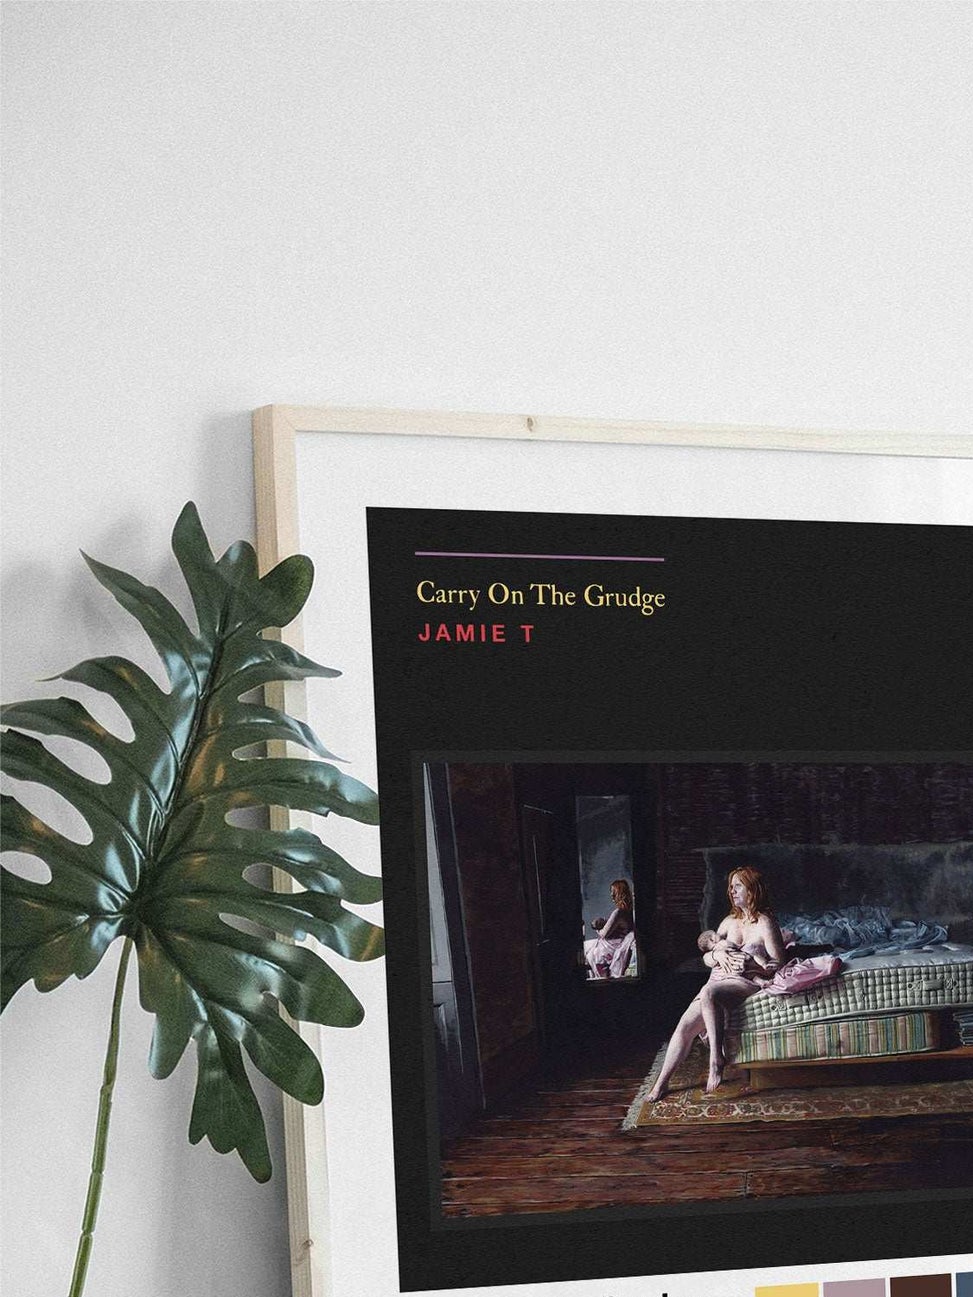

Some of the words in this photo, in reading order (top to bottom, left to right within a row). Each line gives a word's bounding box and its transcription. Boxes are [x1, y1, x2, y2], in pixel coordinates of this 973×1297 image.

[417, 580, 480, 611] Carry
[488, 583, 524, 605] On
[530, 583, 576, 606] The
[584, 584, 665, 616] Grudge
[418, 623, 505, 642] JAMIE
[520, 625, 534, 642] T
